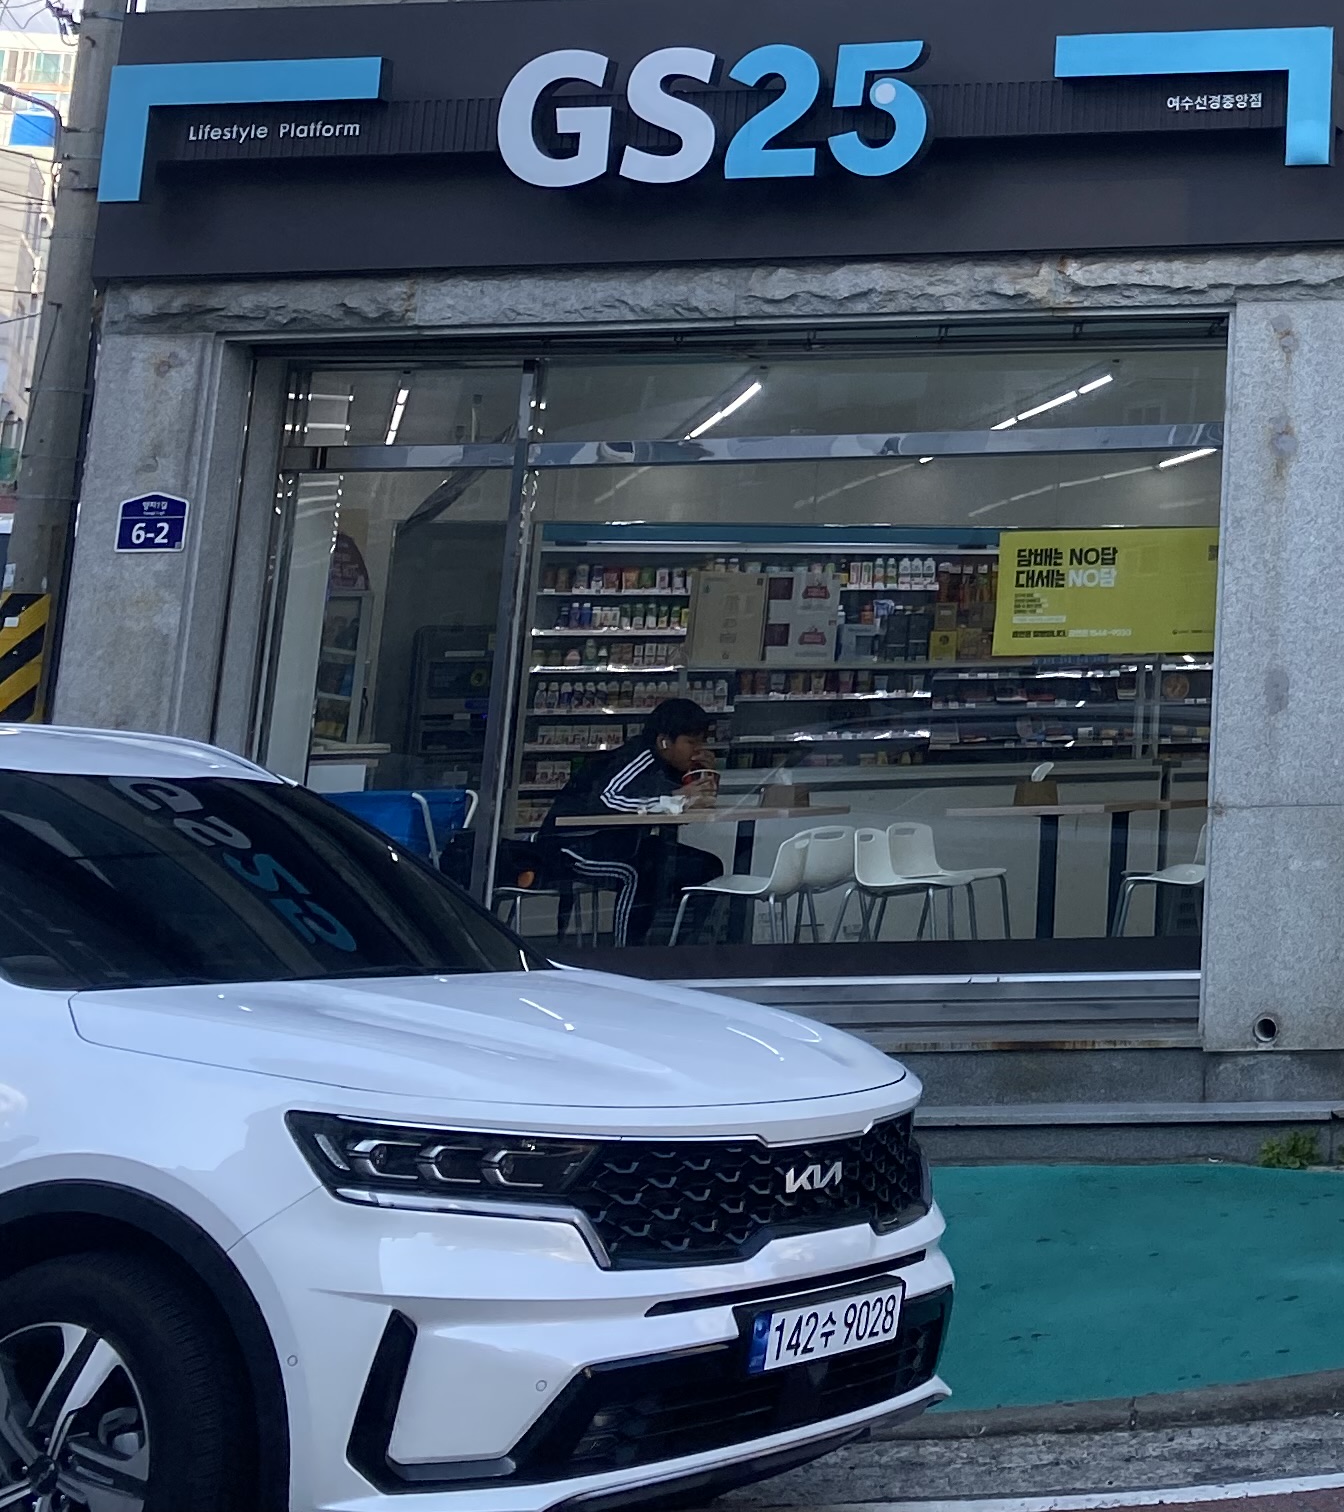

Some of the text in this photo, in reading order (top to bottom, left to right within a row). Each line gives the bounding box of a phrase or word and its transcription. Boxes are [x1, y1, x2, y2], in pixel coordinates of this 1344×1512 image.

[1166, 92, 1263, 112] 여수선경중앙점
[496, 40, 929, 188] GS25
[188, 119, 361, 144] Lifestyle Platform
[131, 522, 170, 545] 6-2
[1016, 547, 1064, 567] 담배는
[1014, 569, 1066, 588] 대세는
[774, 1294, 897, 1362] 142수 9028
